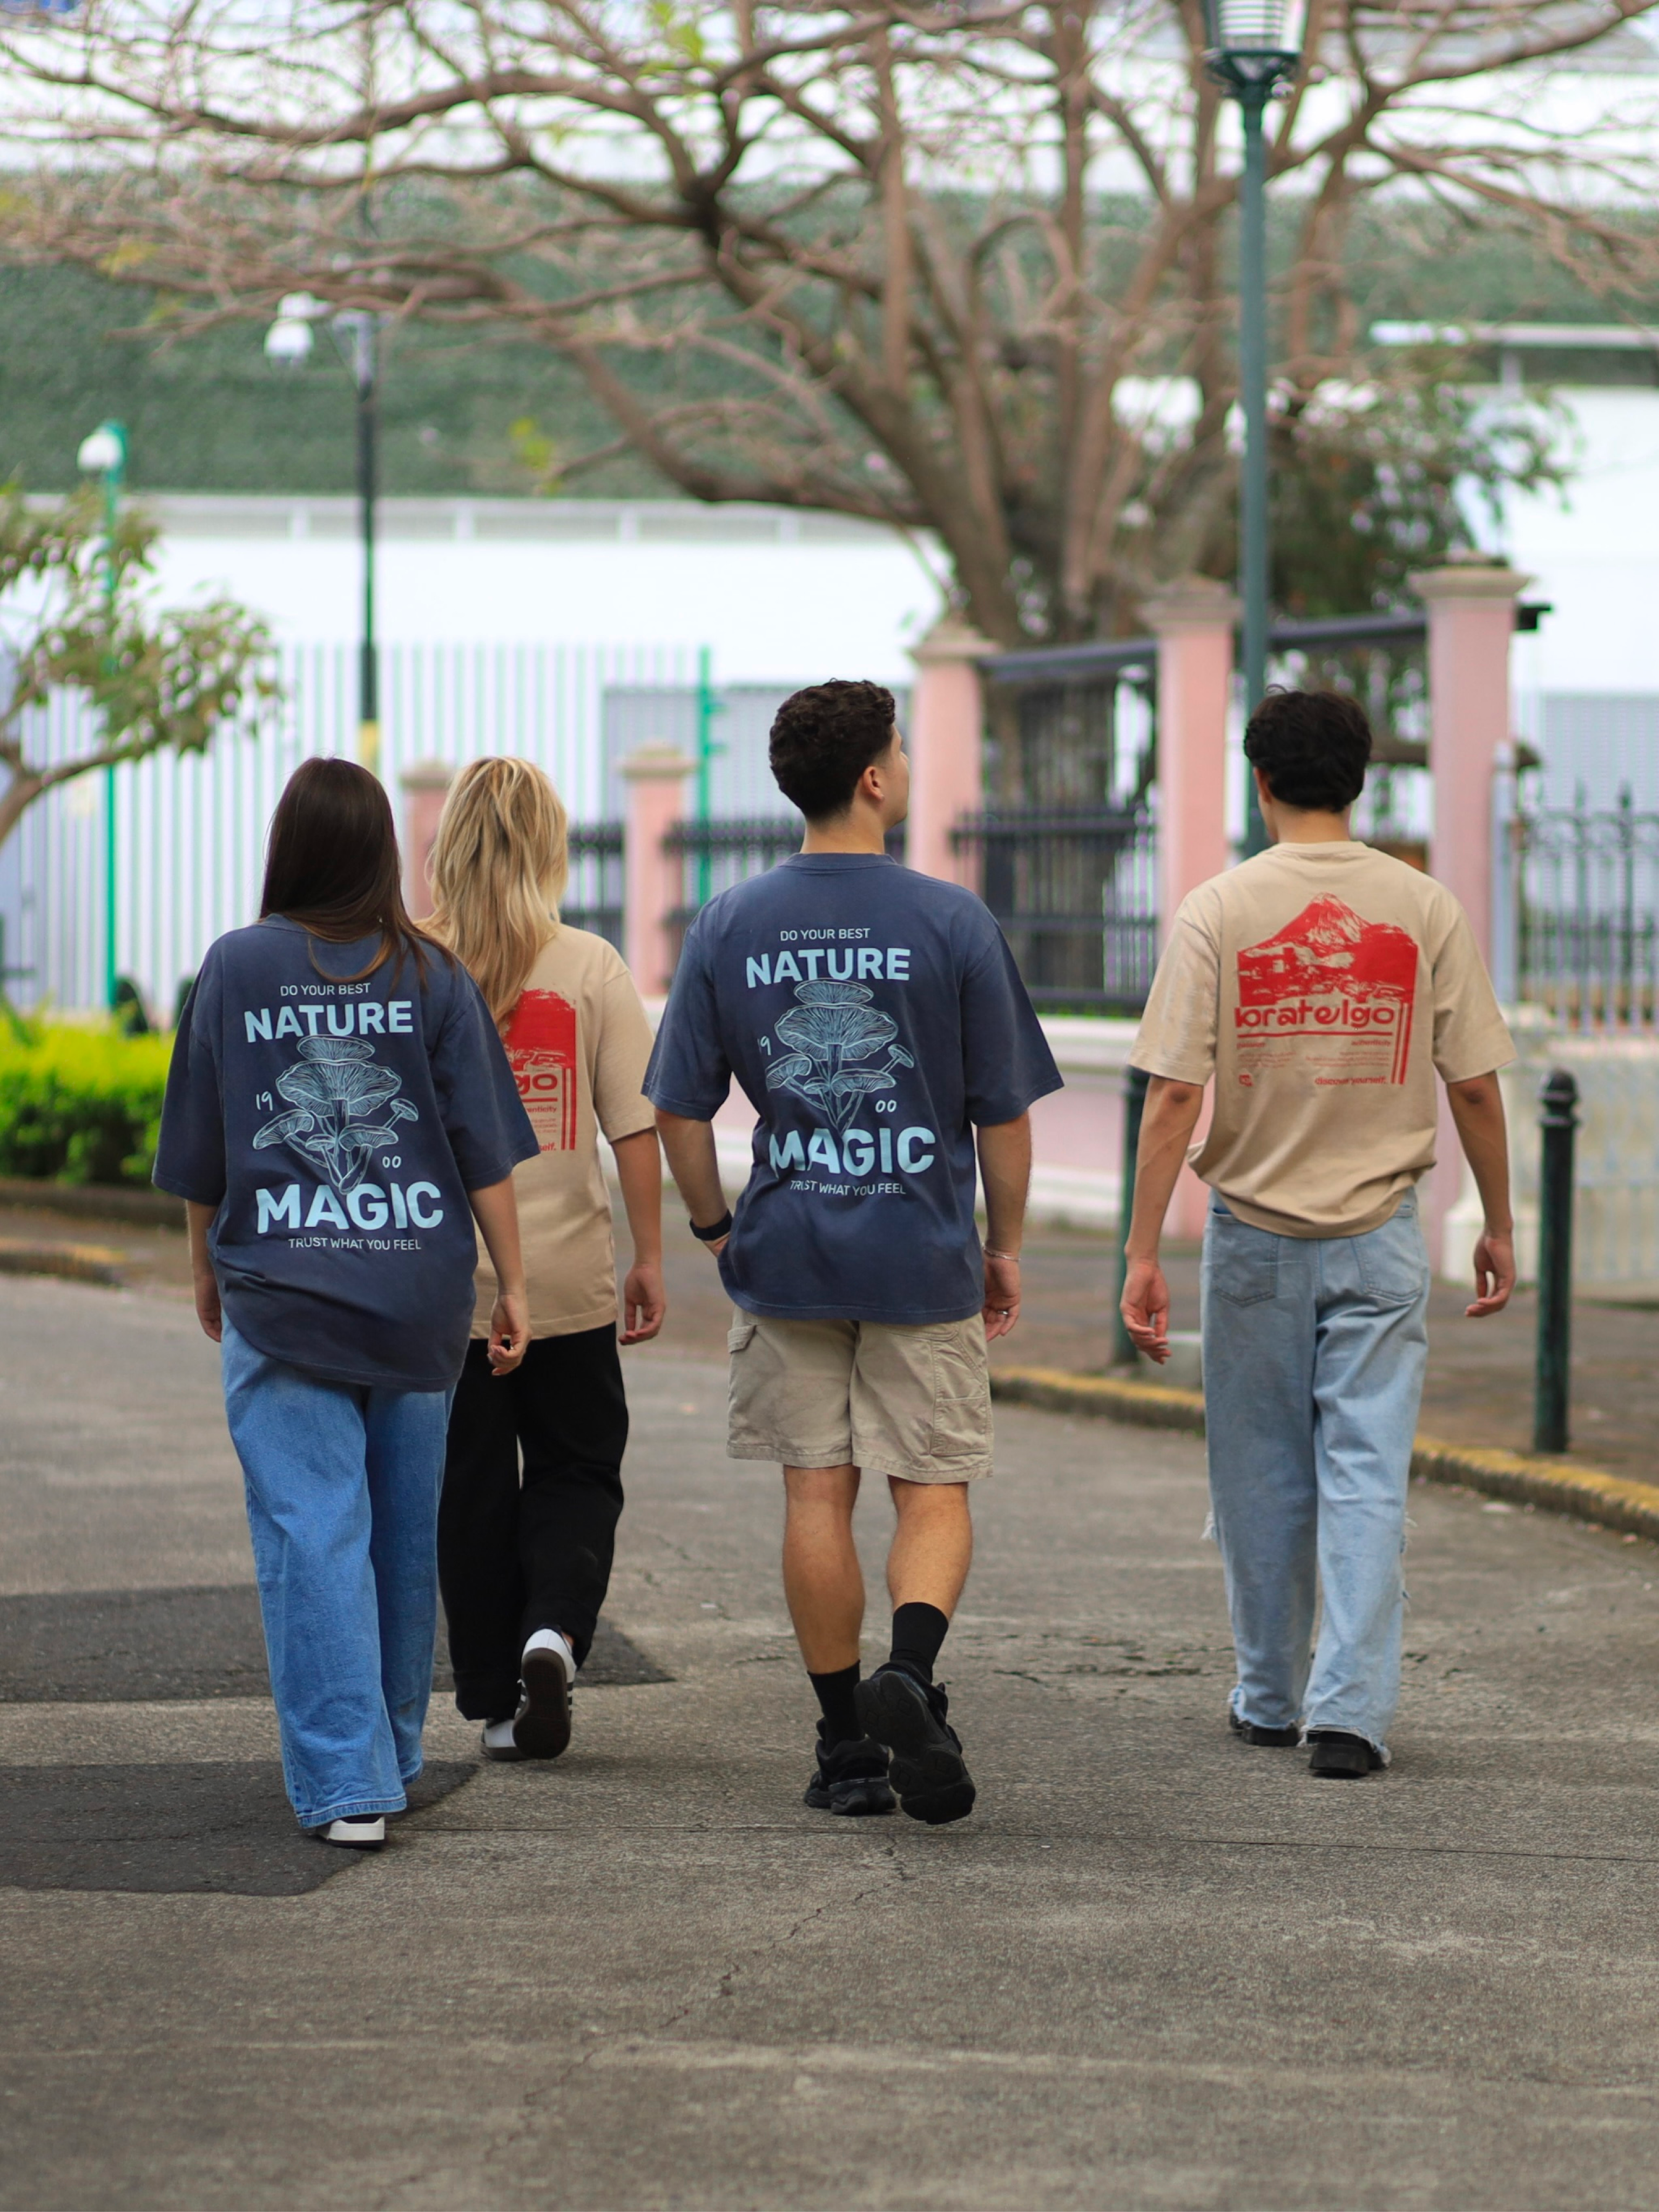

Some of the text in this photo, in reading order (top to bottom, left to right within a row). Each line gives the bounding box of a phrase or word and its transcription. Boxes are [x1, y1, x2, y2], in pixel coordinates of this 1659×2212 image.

[780, 928, 871, 941] DO YOUR BEST
[746, 948, 911, 989] NATURE
[280, 982, 371, 996] DO YOUR BEST
[244, 1001, 413, 1043] NATURE
[256, 1091, 273, 1111] 19
[769, 1127, 935, 1178] MAGIC
[819, 1182, 851, 1196] WHAT
[852, 1184, 875, 1196] YOU
[877, 1183, 906, 1195] FEEL
[255, 1181, 443, 1234] MAGIC
[288, 1236, 422, 1250] TRUST WHAT YOU FEEL
